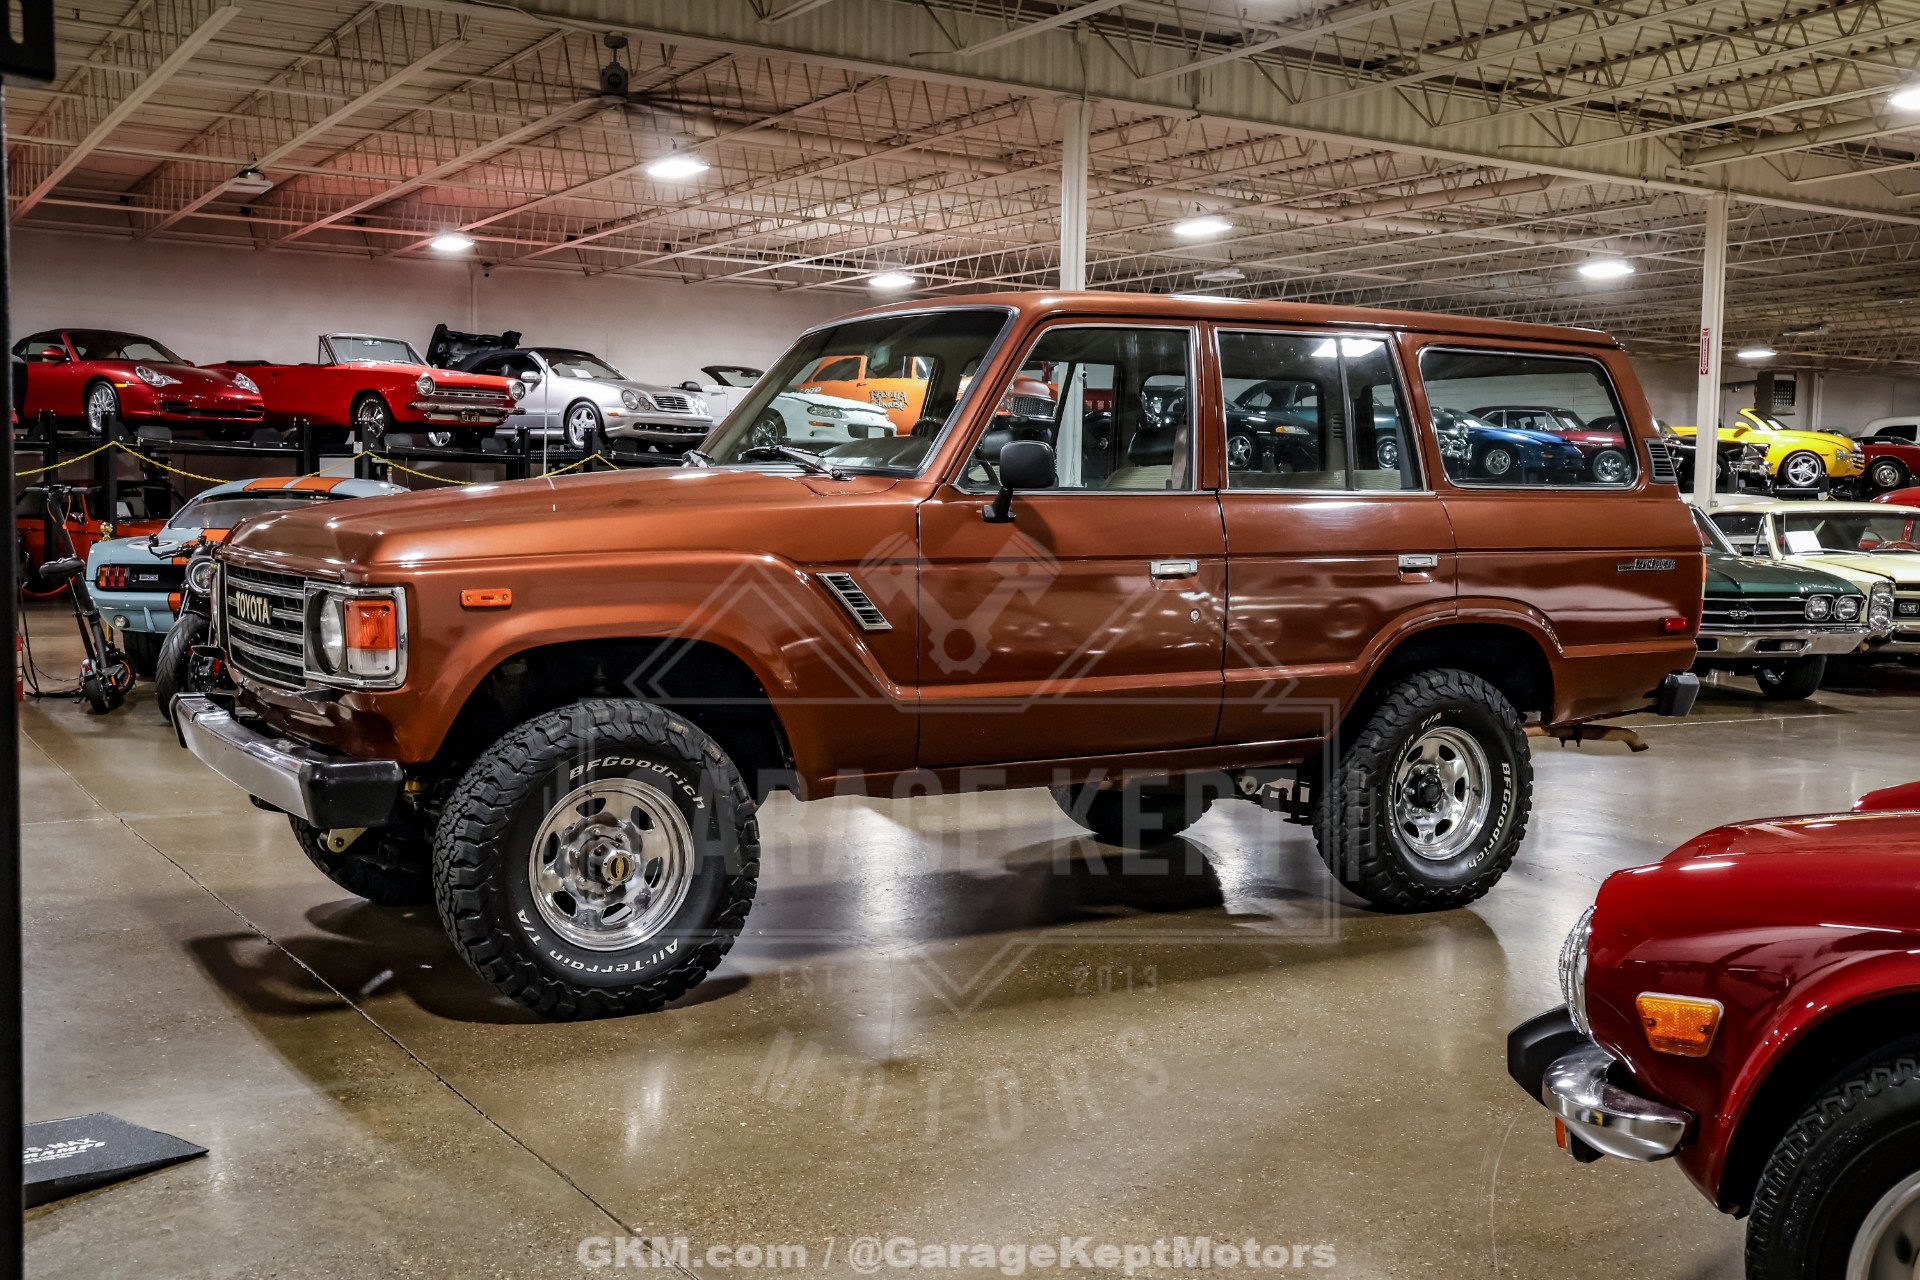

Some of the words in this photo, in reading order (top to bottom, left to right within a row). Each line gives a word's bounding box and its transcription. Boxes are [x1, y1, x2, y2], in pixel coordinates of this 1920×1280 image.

[235, 590, 271, 625] TOYOTA
[1420, 711, 1442, 730] T/A
[569, 756, 706, 810] BFGoodrich
[1468, 762, 1512, 869] BFGoodrich
[516, 908, 542, 947] T/A
[549, 937, 679, 974] All-Terrain
